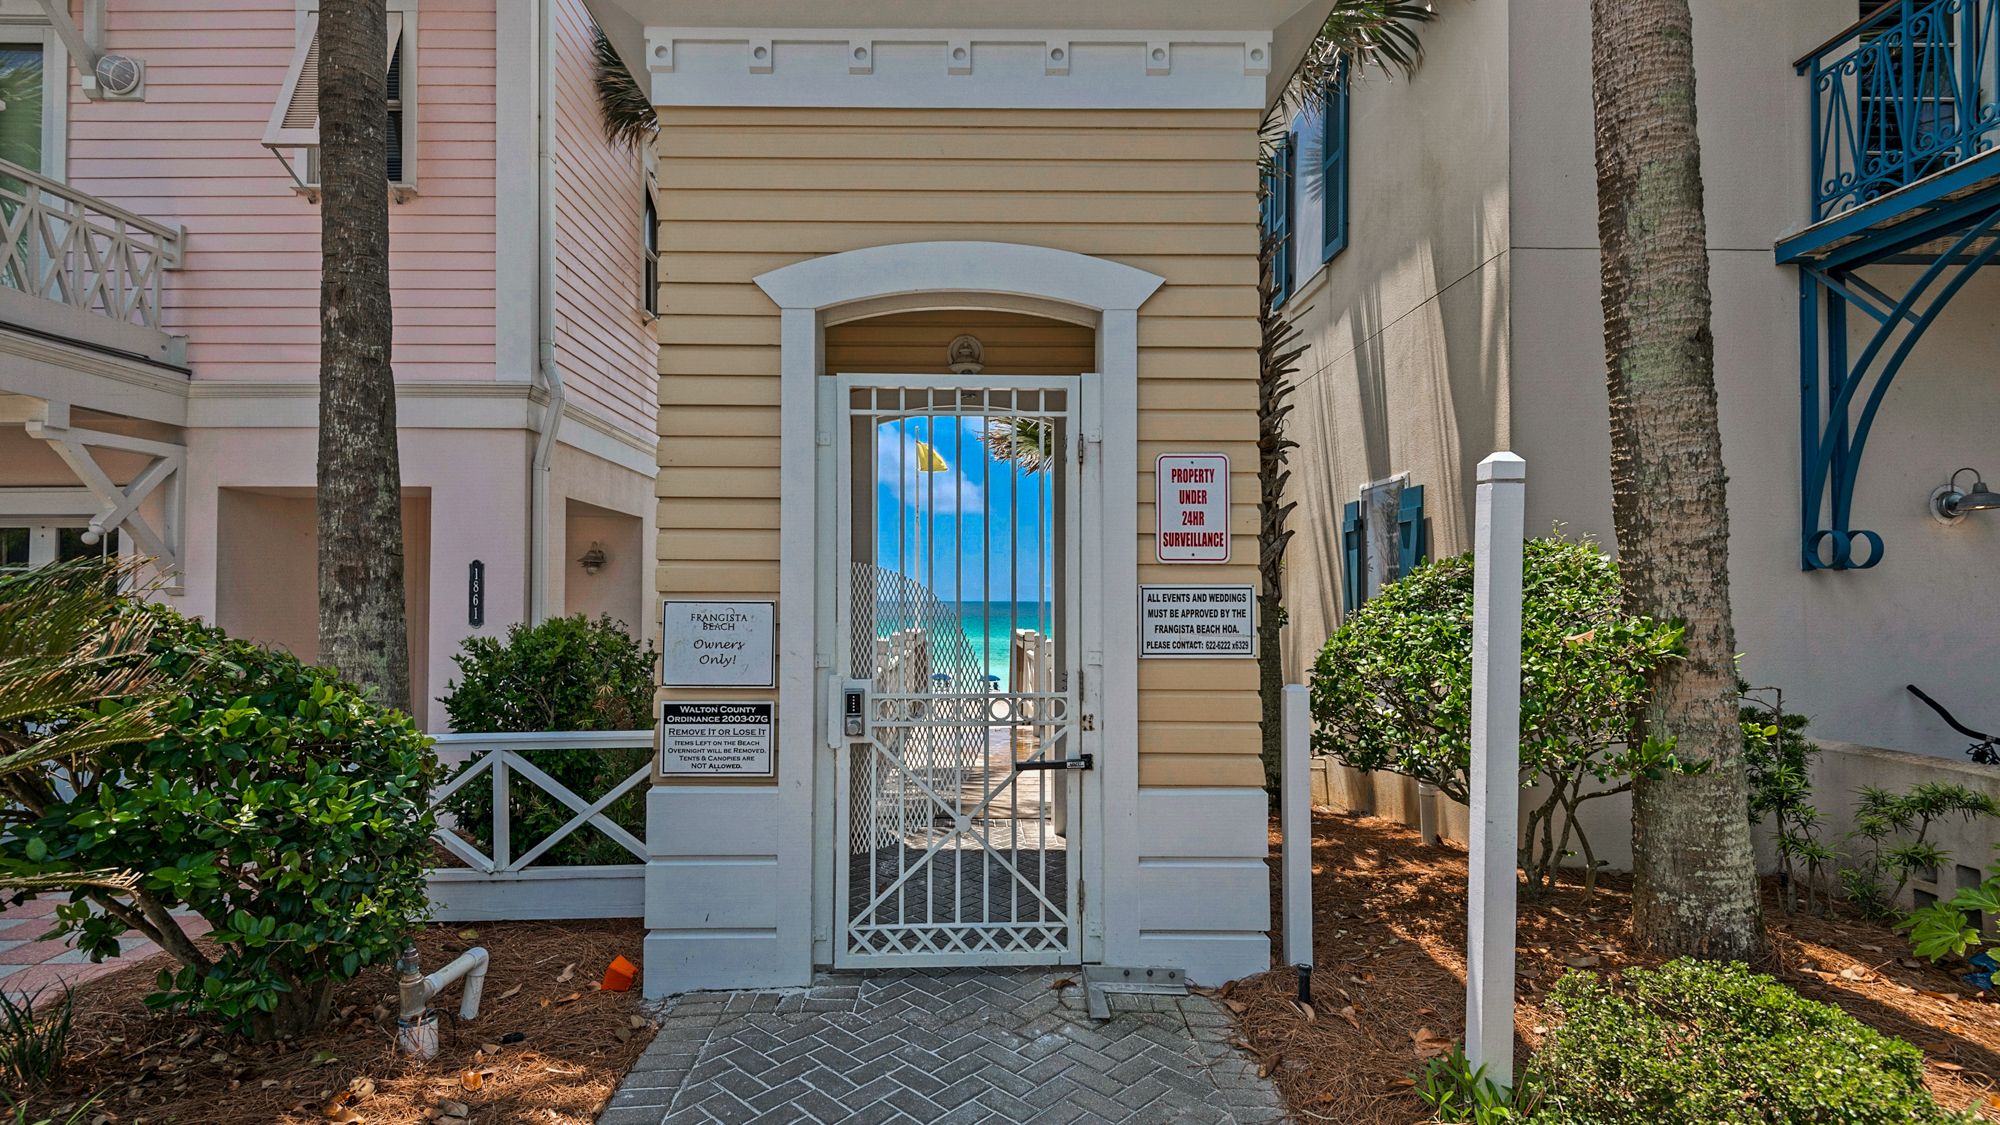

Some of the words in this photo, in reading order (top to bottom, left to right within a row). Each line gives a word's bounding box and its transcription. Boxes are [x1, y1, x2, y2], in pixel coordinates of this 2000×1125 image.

[1172, 469, 1215, 483] PROPERTY
[1179, 490, 1207, 504] UNDER
[1182, 511, 1204, 526] 24HR
[1163, 532, 1224, 547] SURVEILLANCE
[1147, 594, 1160, 602] ALL
[1162, 594, 1190, 602] EVENTS
[1192, 594, 1206, 602] AND
[1209, 594, 1246, 602] WEDDINGS
[690, 613, 747, 622] FRANGISTA
[1148, 609, 1168, 618] MUST
[1170, 609, 1179, 618] BE
[1181, 609, 1218, 618] APPROVED
[1221, 609, 1230, 618] BY
[1232, 609, 1246, 618] THE
[702, 623, 735, 631] BEACH
[1154, 625, 1194, 634] FRANGISTA
[1197, 625, 1220, 634] BEACH
[1222, 625, 1240, 634] HOA.
[693, 639, 745, 650] Owners
[1146, 641, 1170, 649] PLEASE
[1172, 641, 1204, 649] CONTACT:
[700, 654, 737, 668] Only!
[667, 715, 720, 723] ORDINANCE
[722, 715, 768, 723] 2003-07G
